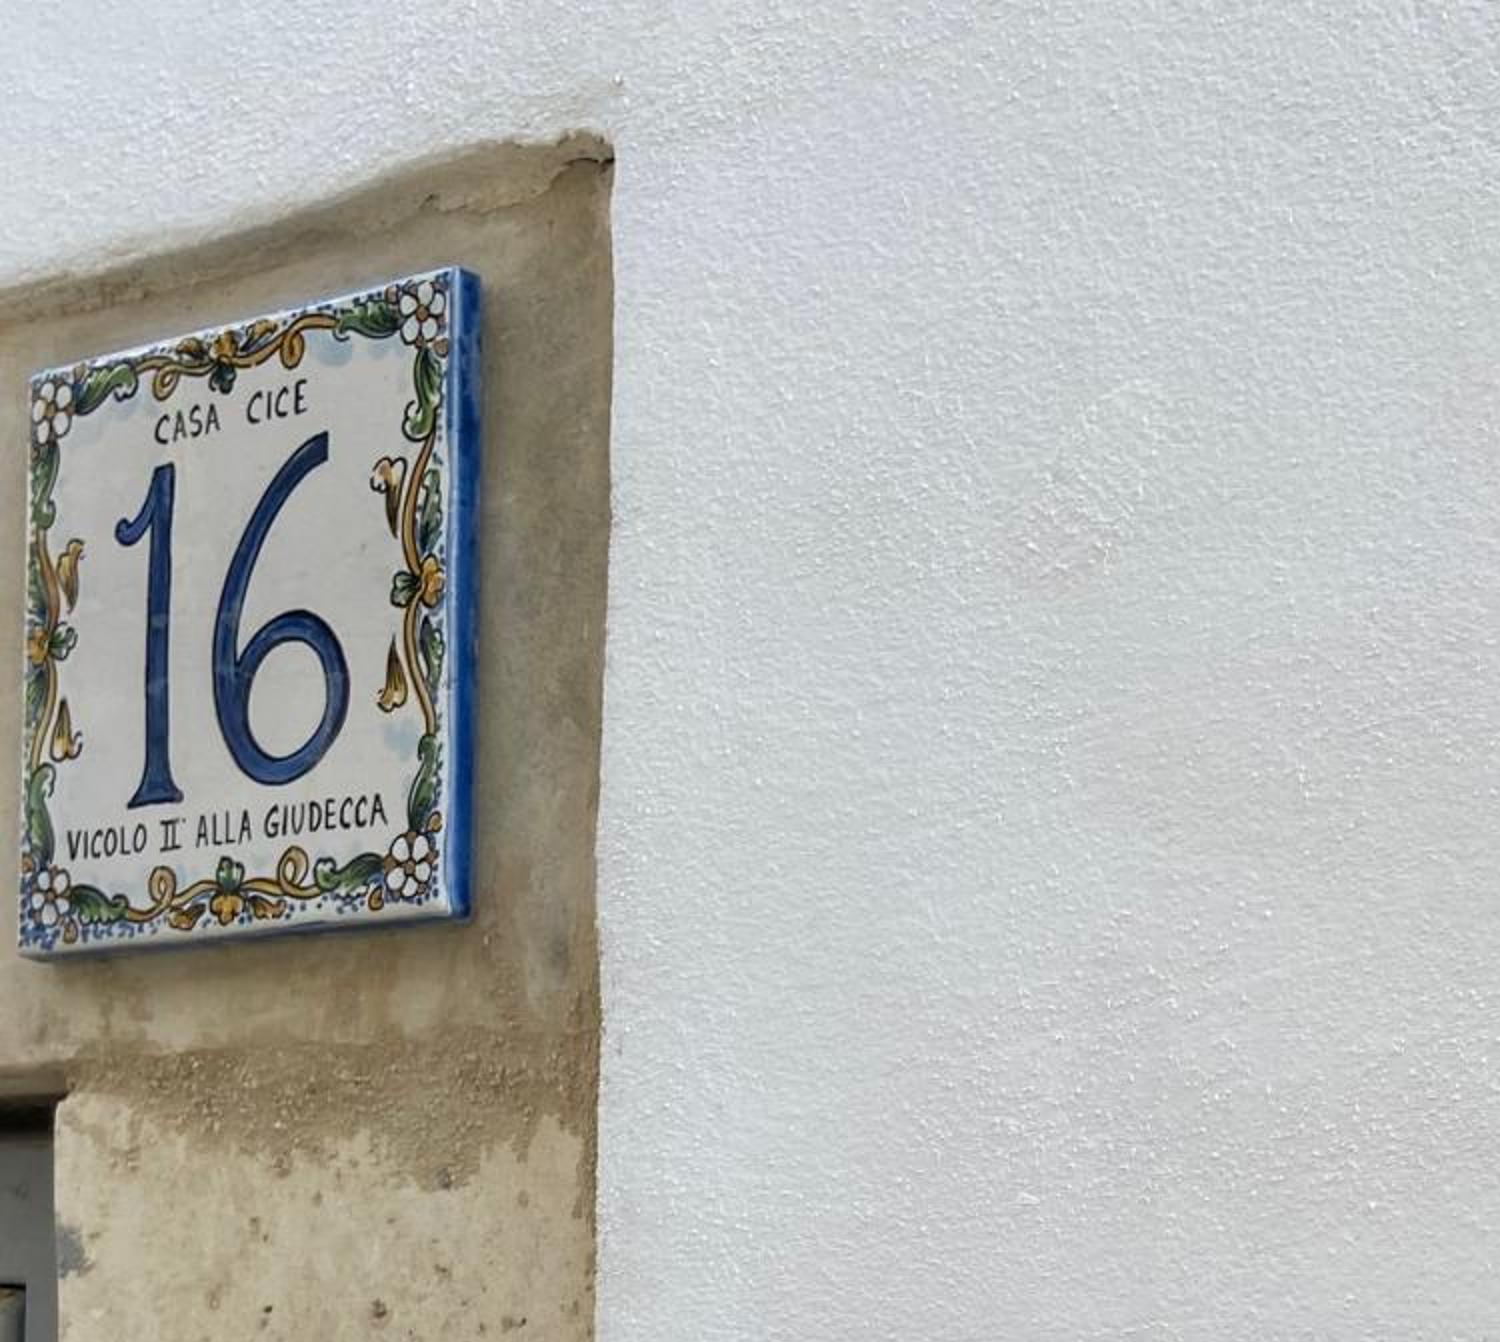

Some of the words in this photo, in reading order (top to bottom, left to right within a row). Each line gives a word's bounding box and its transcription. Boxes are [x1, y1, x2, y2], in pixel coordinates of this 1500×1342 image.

[154, 403, 221, 445] CASA
[246, 379, 308, 425] CICE
[115, 431, 350, 809] 16
[67, 830, 148, 861] VICOLO
[196, 812, 252, 847] ALLA
[263, 793, 388, 838] GIUDECCA
